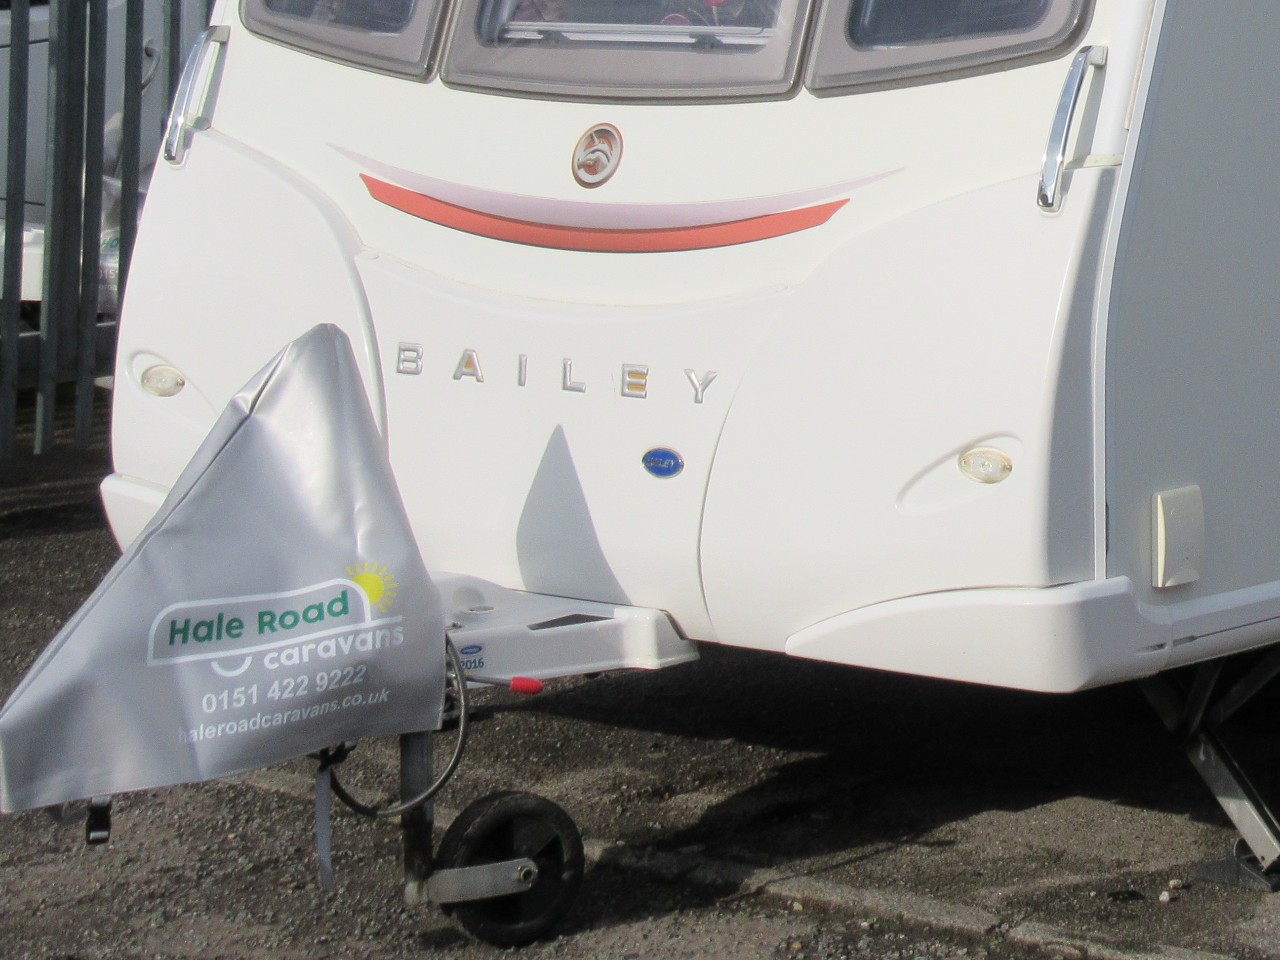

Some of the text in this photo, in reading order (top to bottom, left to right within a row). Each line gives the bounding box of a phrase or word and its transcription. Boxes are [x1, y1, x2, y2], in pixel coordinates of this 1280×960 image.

[397, 342, 718, 405] BAILEY
[168, 590, 350, 646] Hale Road
[262, 626, 405, 670] caravans
[178, 688, 390, 742] haleroadcaravans.co.uk
[202, 664, 367, 714] 0151 422 9222
